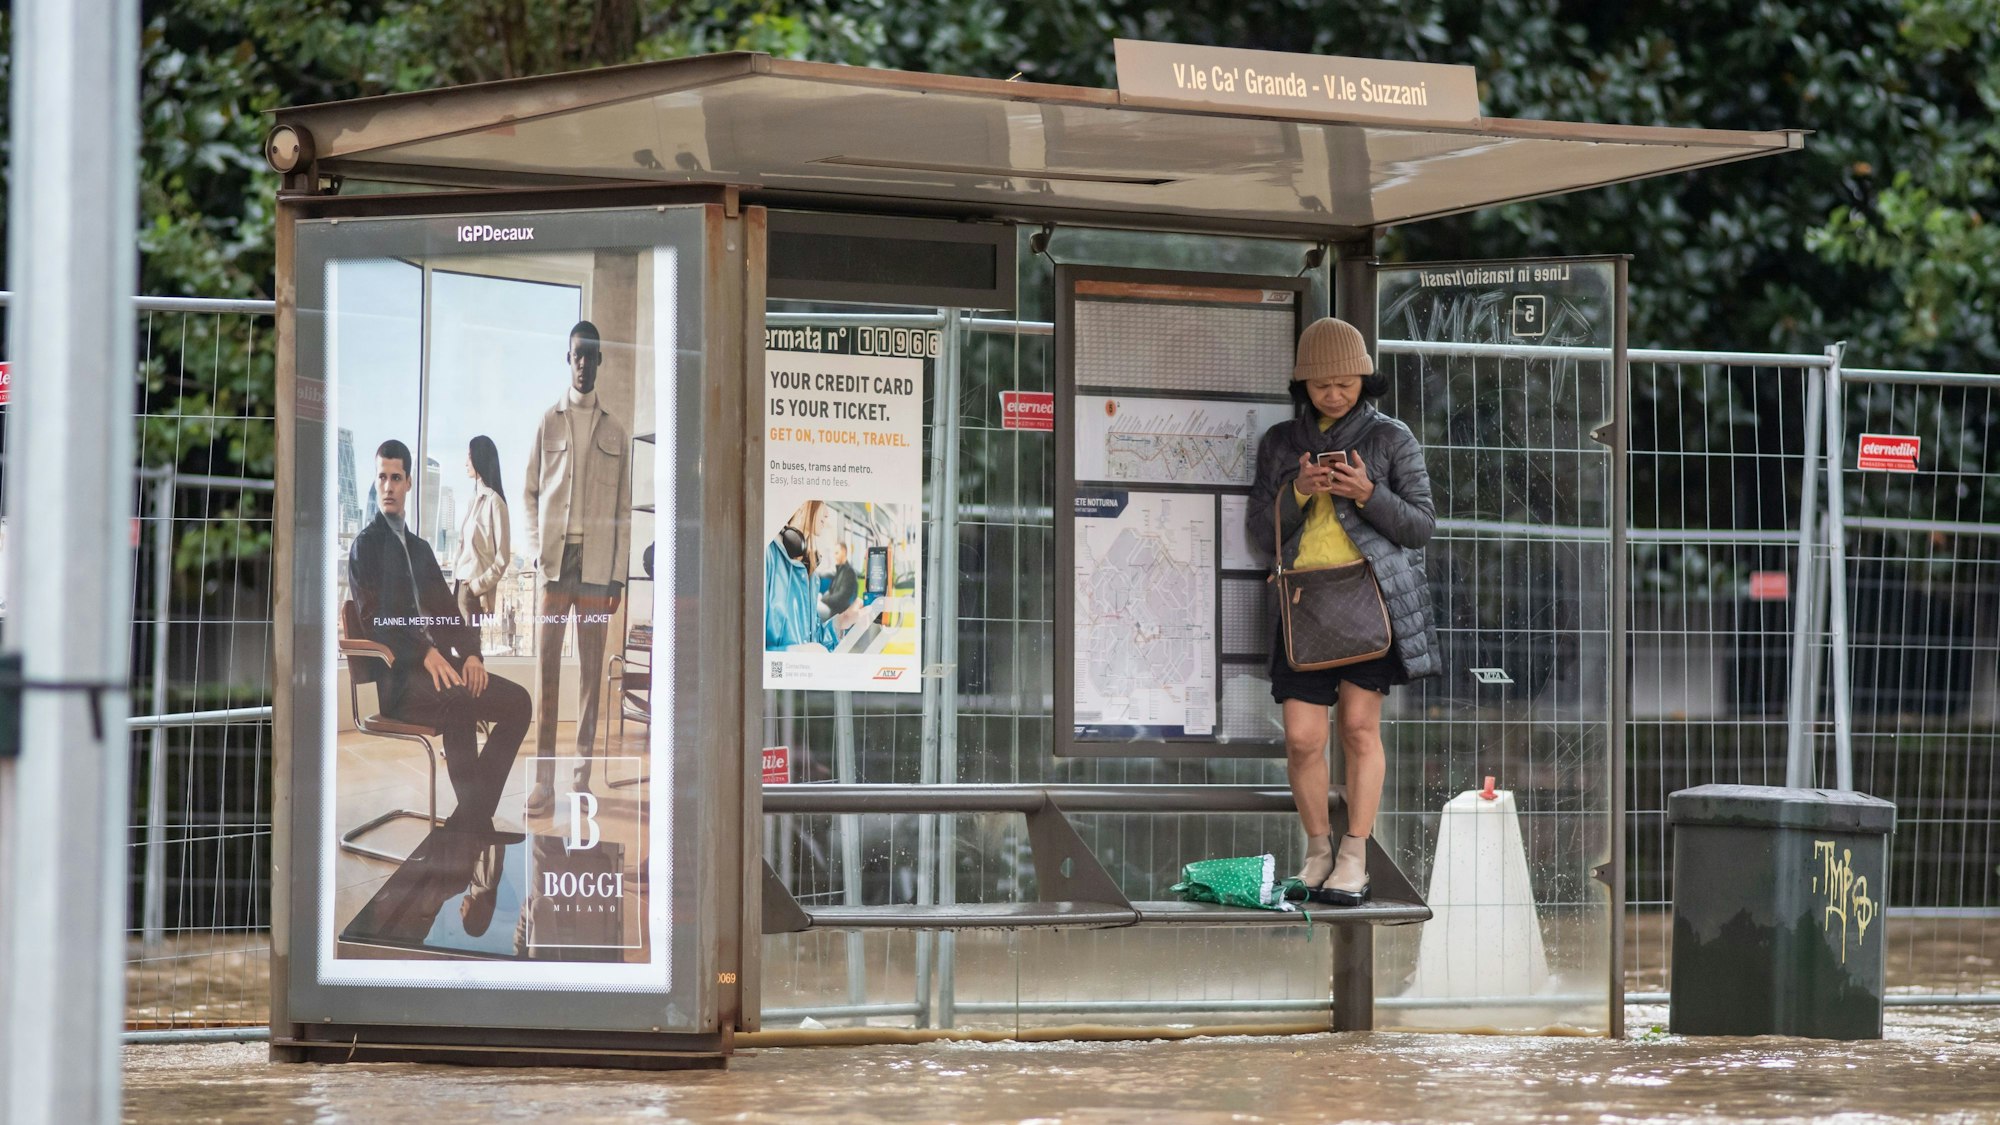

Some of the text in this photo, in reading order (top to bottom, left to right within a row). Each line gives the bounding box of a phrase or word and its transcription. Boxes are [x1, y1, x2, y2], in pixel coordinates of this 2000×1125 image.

[1173, 63, 1207, 91] V.le
[1211, 65, 1239, 93] Ca'
[1245, 68, 1307, 98] Granda
[1323, 74, 1357, 102] V.le
[1360, 77, 1428, 106] Suzzani
[457, 225, 535, 242] IGPDecaux
[764, 326, 941, 356] ermata n° 11966
[770, 370, 914, 396] YOUR CREDIT CARD
[770, 398, 890, 421] IS YOUR TICKET.
[1007, 401, 1054, 414] eterned
[770, 427, 911, 447] GET ON, TOUCH, TRAVEL.
[1863, 442, 1917, 457] eternedile
[770, 460, 873, 474] On buses, trams and metro.
[770, 474, 789, 486] Easy,
[790, 475, 805, 485] fast
[806, 477, 820, 486] and
[822, 478, 831, 486] no
[1074, 497, 1087, 506] ETE
[373, 617, 407, 626] FLANNEL
[408, 616, 434, 626] MEETS
[435, 616, 460, 626] STYLE
[560, 614, 582, 624] SHRT
[583, 613, 613, 624] JACKET
[882, 669, 897, 677] ATM
[565, 792, 601, 850] B
[543, 871, 624, 898] BOGGI
[553, 904, 616, 913] MILANO
